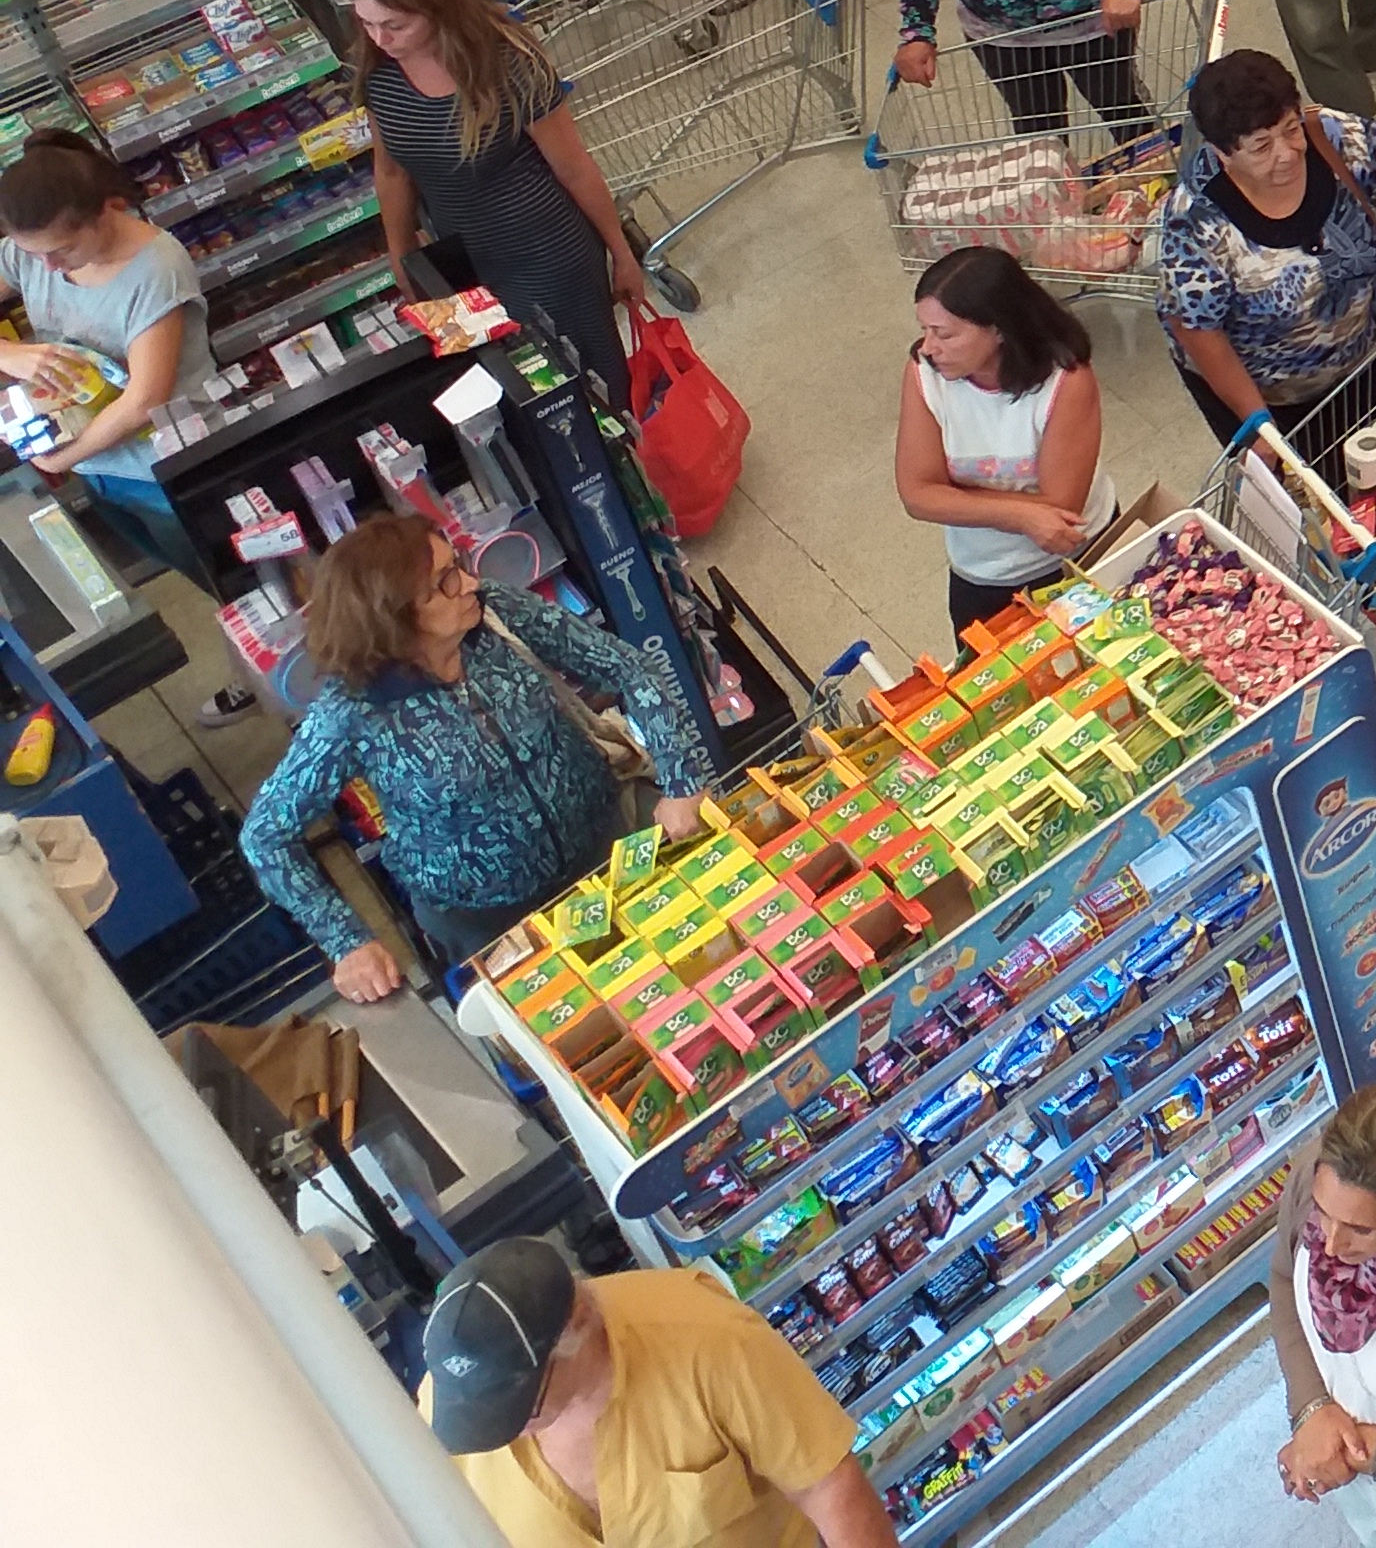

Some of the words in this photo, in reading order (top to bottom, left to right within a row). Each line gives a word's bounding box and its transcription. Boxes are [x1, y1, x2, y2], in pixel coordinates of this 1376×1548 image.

[571, 470, 604, 495] MEJOR
[600, 545, 636, 571] BUENO
[973, 668, 994, 686] BC
[920, 708, 943, 727] BC
[1070, 730, 1092, 747] BC
[974, 750, 995, 768] BC
[1012, 768, 1034, 786] BC
[805, 784, 829, 810] BC
[838, 801, 861, 820] BC
[959, 803, 981, 823] BC
[869, 823, 891, 841] BC
[782, 840, 804, 859] BC
[912, 857, 934, 879] BC
[840, 886, 864, 906] BC
[757, 900, 780, 920] BC
[786, 926, 808, 947] BC
[724, 967, 747, 989] BC
[638, 983, 662, 1004] BC
[666, 1011, 690, 1032] BC
[1258, 1021, 1296, 1043] Tofi
[1208, 1062, 1246, 1087] Tofi
